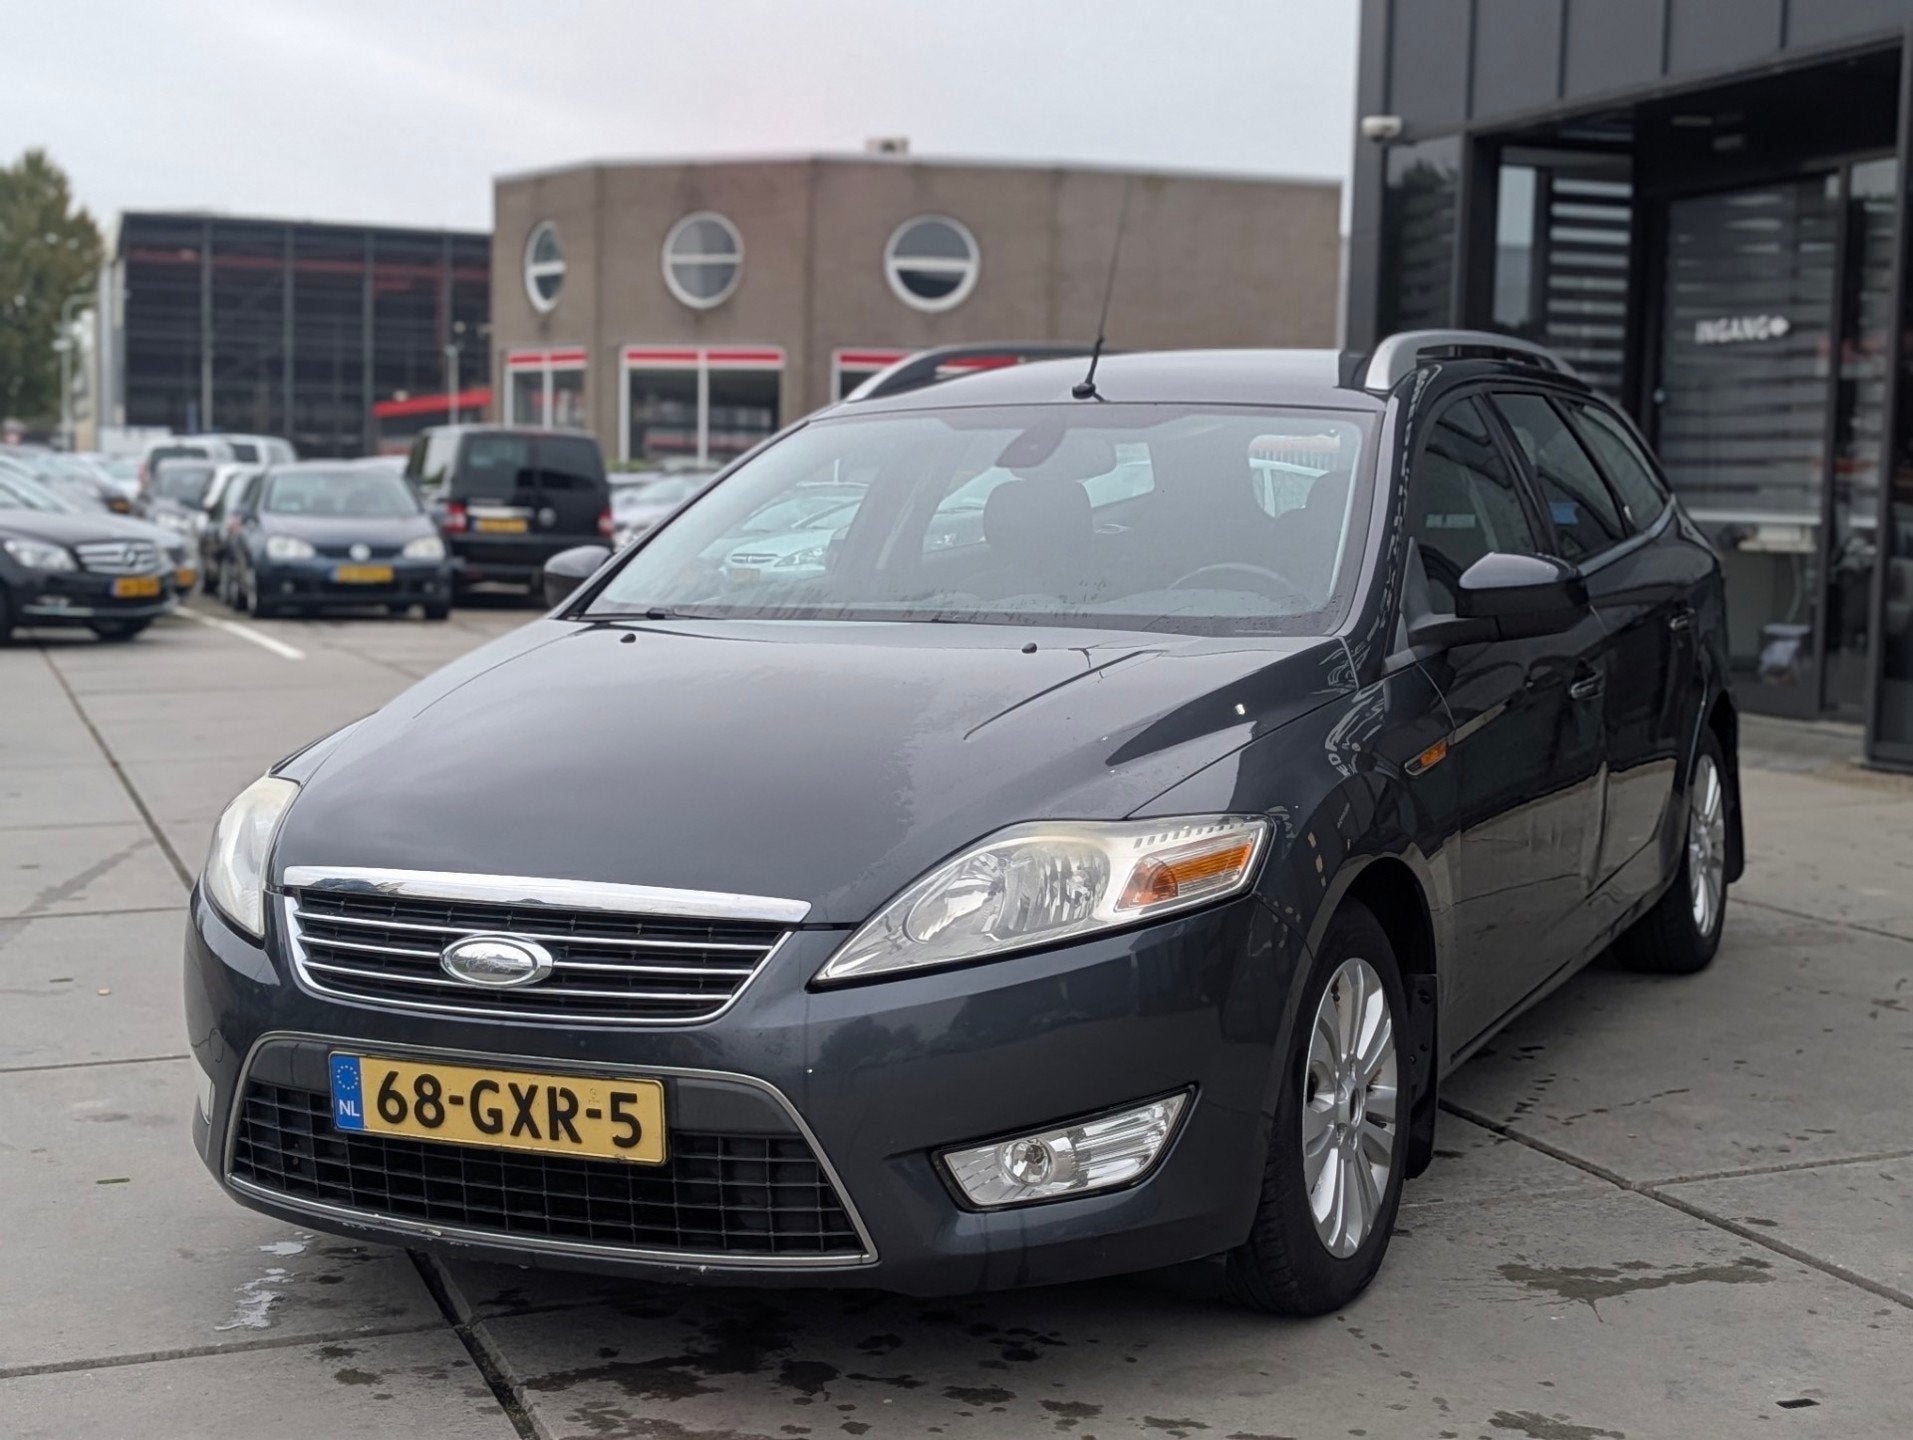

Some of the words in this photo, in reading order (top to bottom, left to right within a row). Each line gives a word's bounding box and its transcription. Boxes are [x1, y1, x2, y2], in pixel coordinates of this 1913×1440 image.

[1695, 315, 1768, 343] INGANG
[339, 1099, 360, 1117] NL
[377, 1071, 642, 1148] 68-GXR-5
